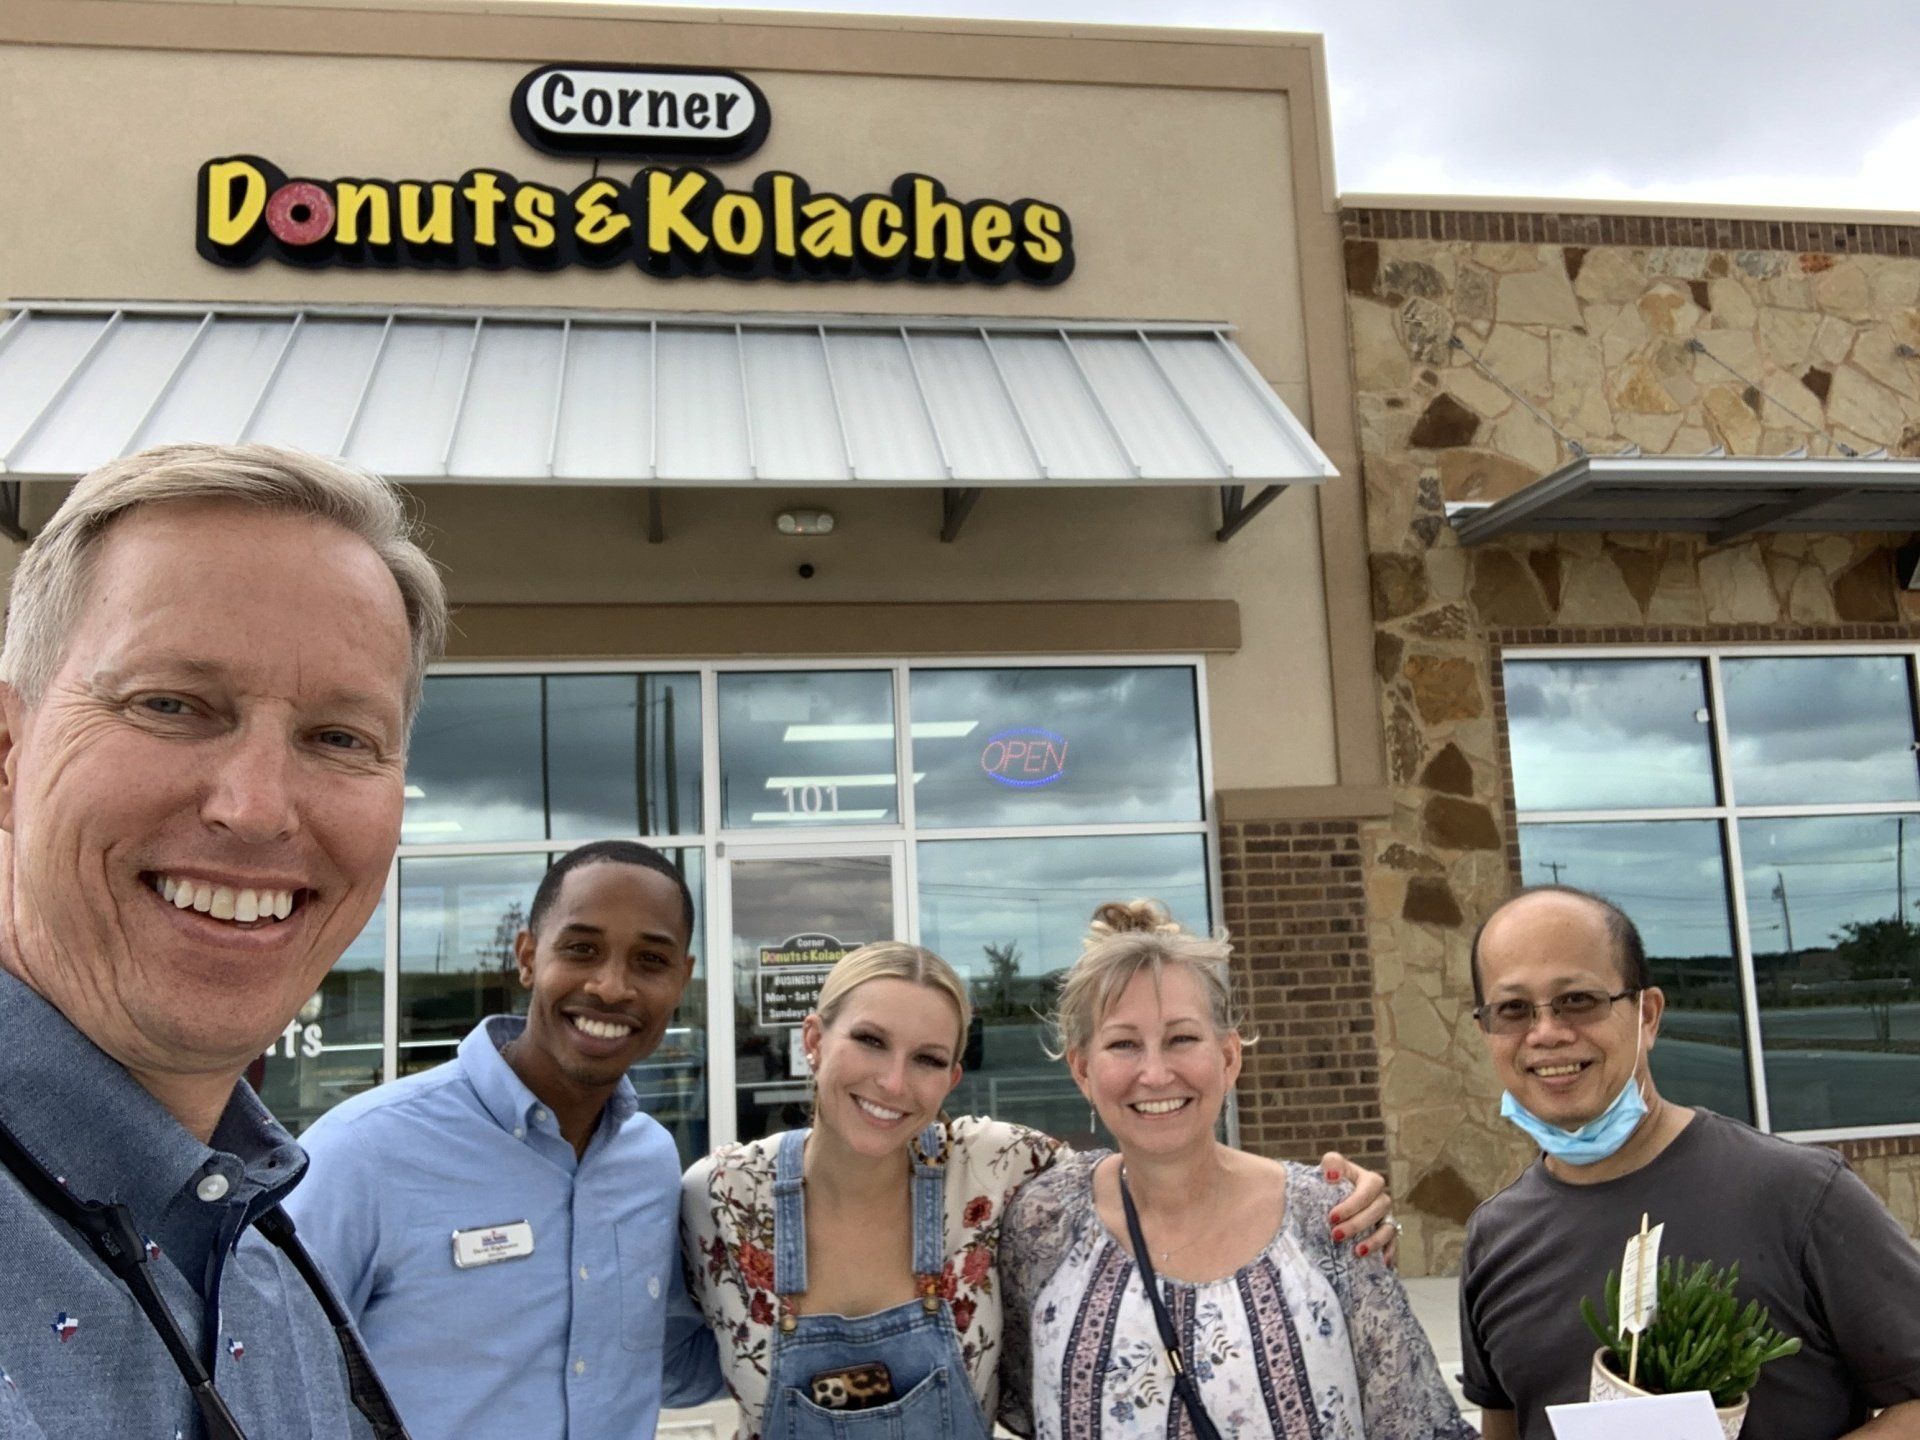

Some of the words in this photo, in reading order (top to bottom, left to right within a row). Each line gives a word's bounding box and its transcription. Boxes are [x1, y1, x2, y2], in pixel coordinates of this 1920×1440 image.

[541, 73, 740, 131] Corner
[208, 161, 555, 248] Donuts
[576, 182, 628, 244] &
[648, 171, 1062, 263] Kolaches
[981, 741, 1067, 772] OPEN
[782, 784, 838, 815] 101
[797, 939, 825, 947] Corner
[762, 950, 801, 963] Donuts
[810, 949, 847, 960] Kolach
[775, 975, 816, 985] BUSINESS
[765, 992, 786, 1002] Mon
[794, 991, 810, 1001] Sat
